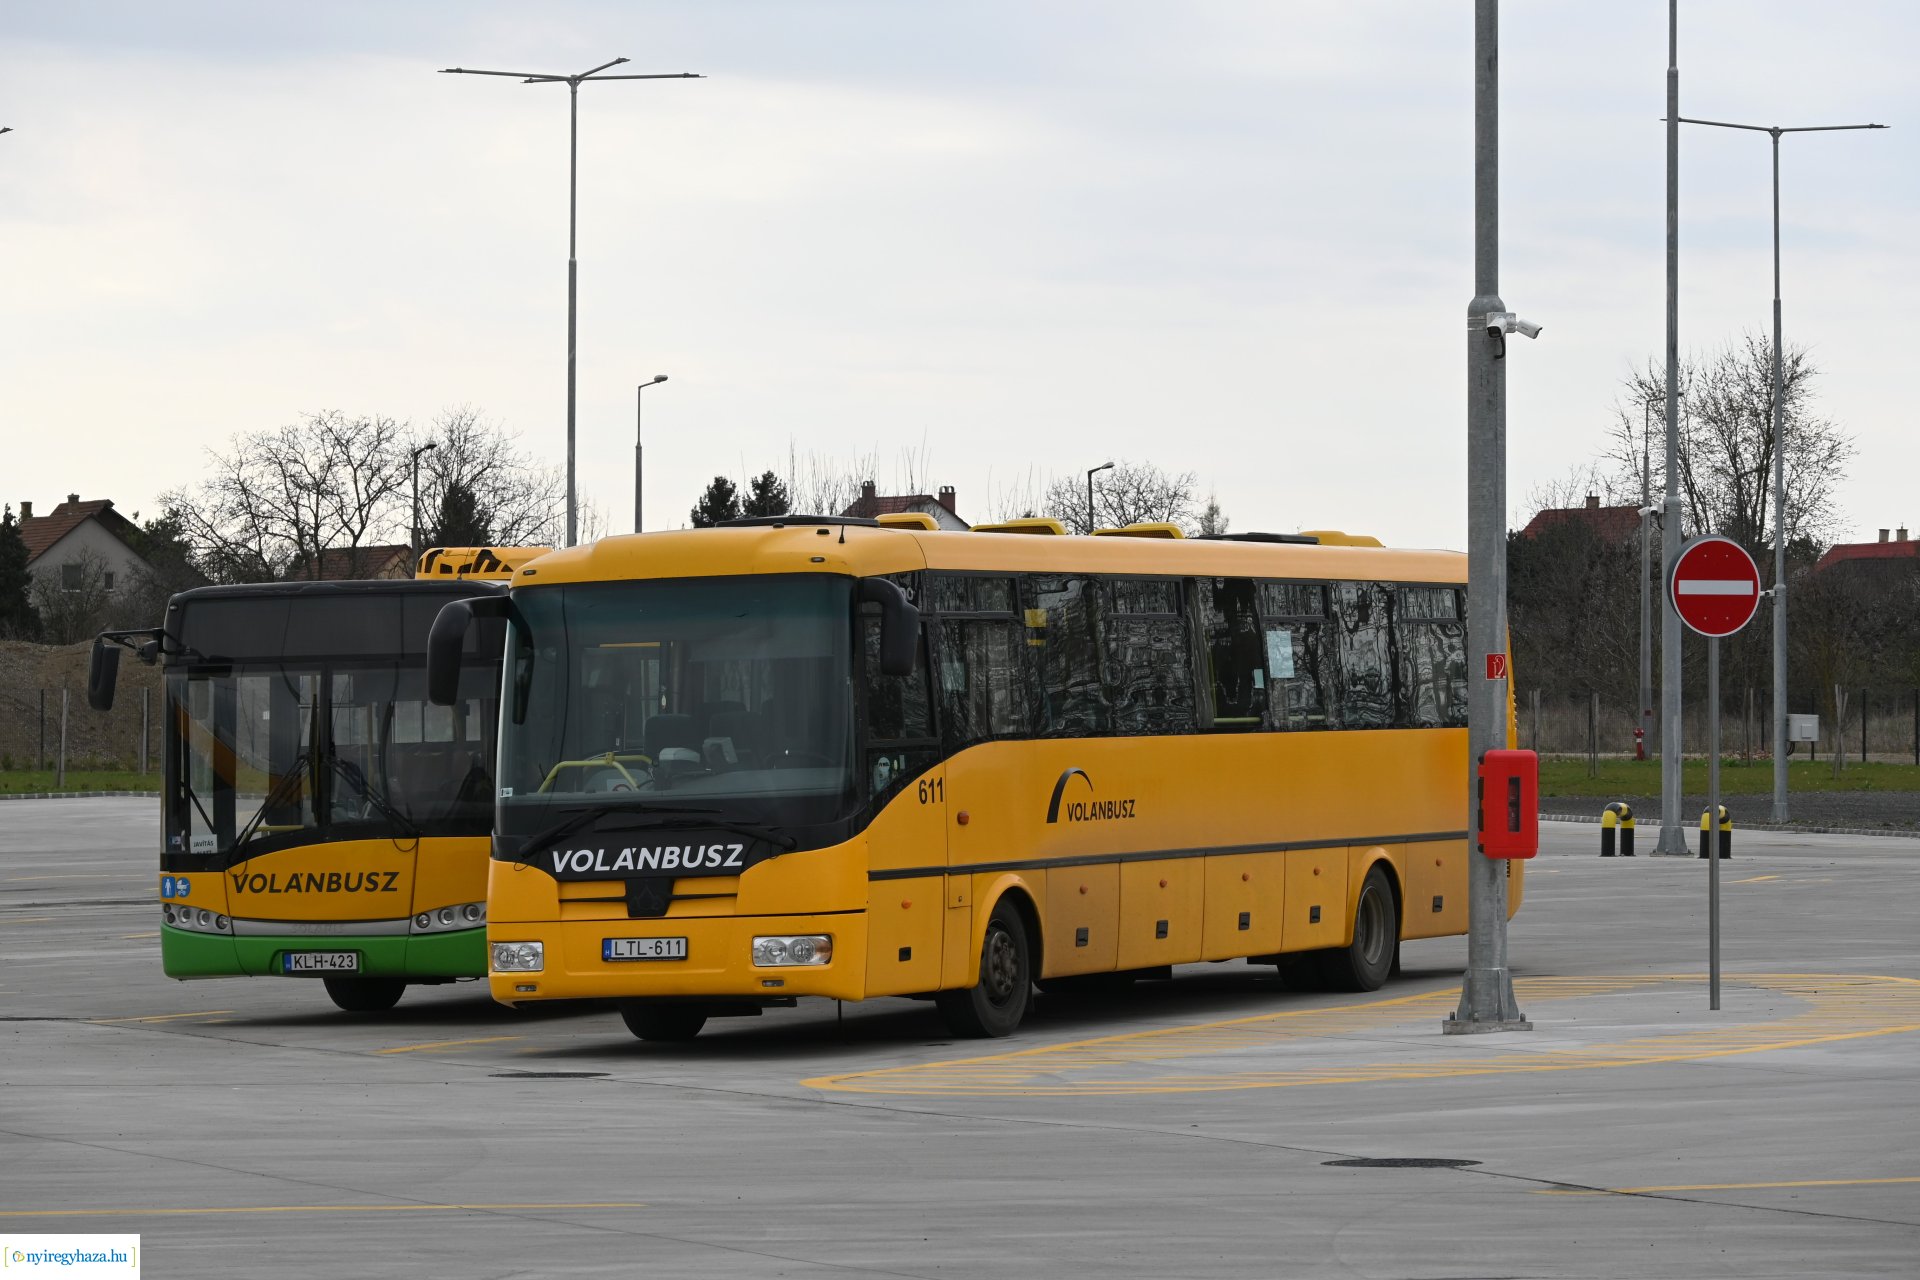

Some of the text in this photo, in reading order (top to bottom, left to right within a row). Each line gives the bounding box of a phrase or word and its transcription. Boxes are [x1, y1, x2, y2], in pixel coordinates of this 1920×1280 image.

[918, 777, 944, 804] 611
[1067, 799, 1136, 822] VOLÁNBUSZ
[552, 843, 744, 873] VOLÁNBUSZ
[233, 872, 400, 894] VOLÁNBUSZ
[614, 940, 681, 956] LTL-611
[294, 954, 354, 969] KLH-423
